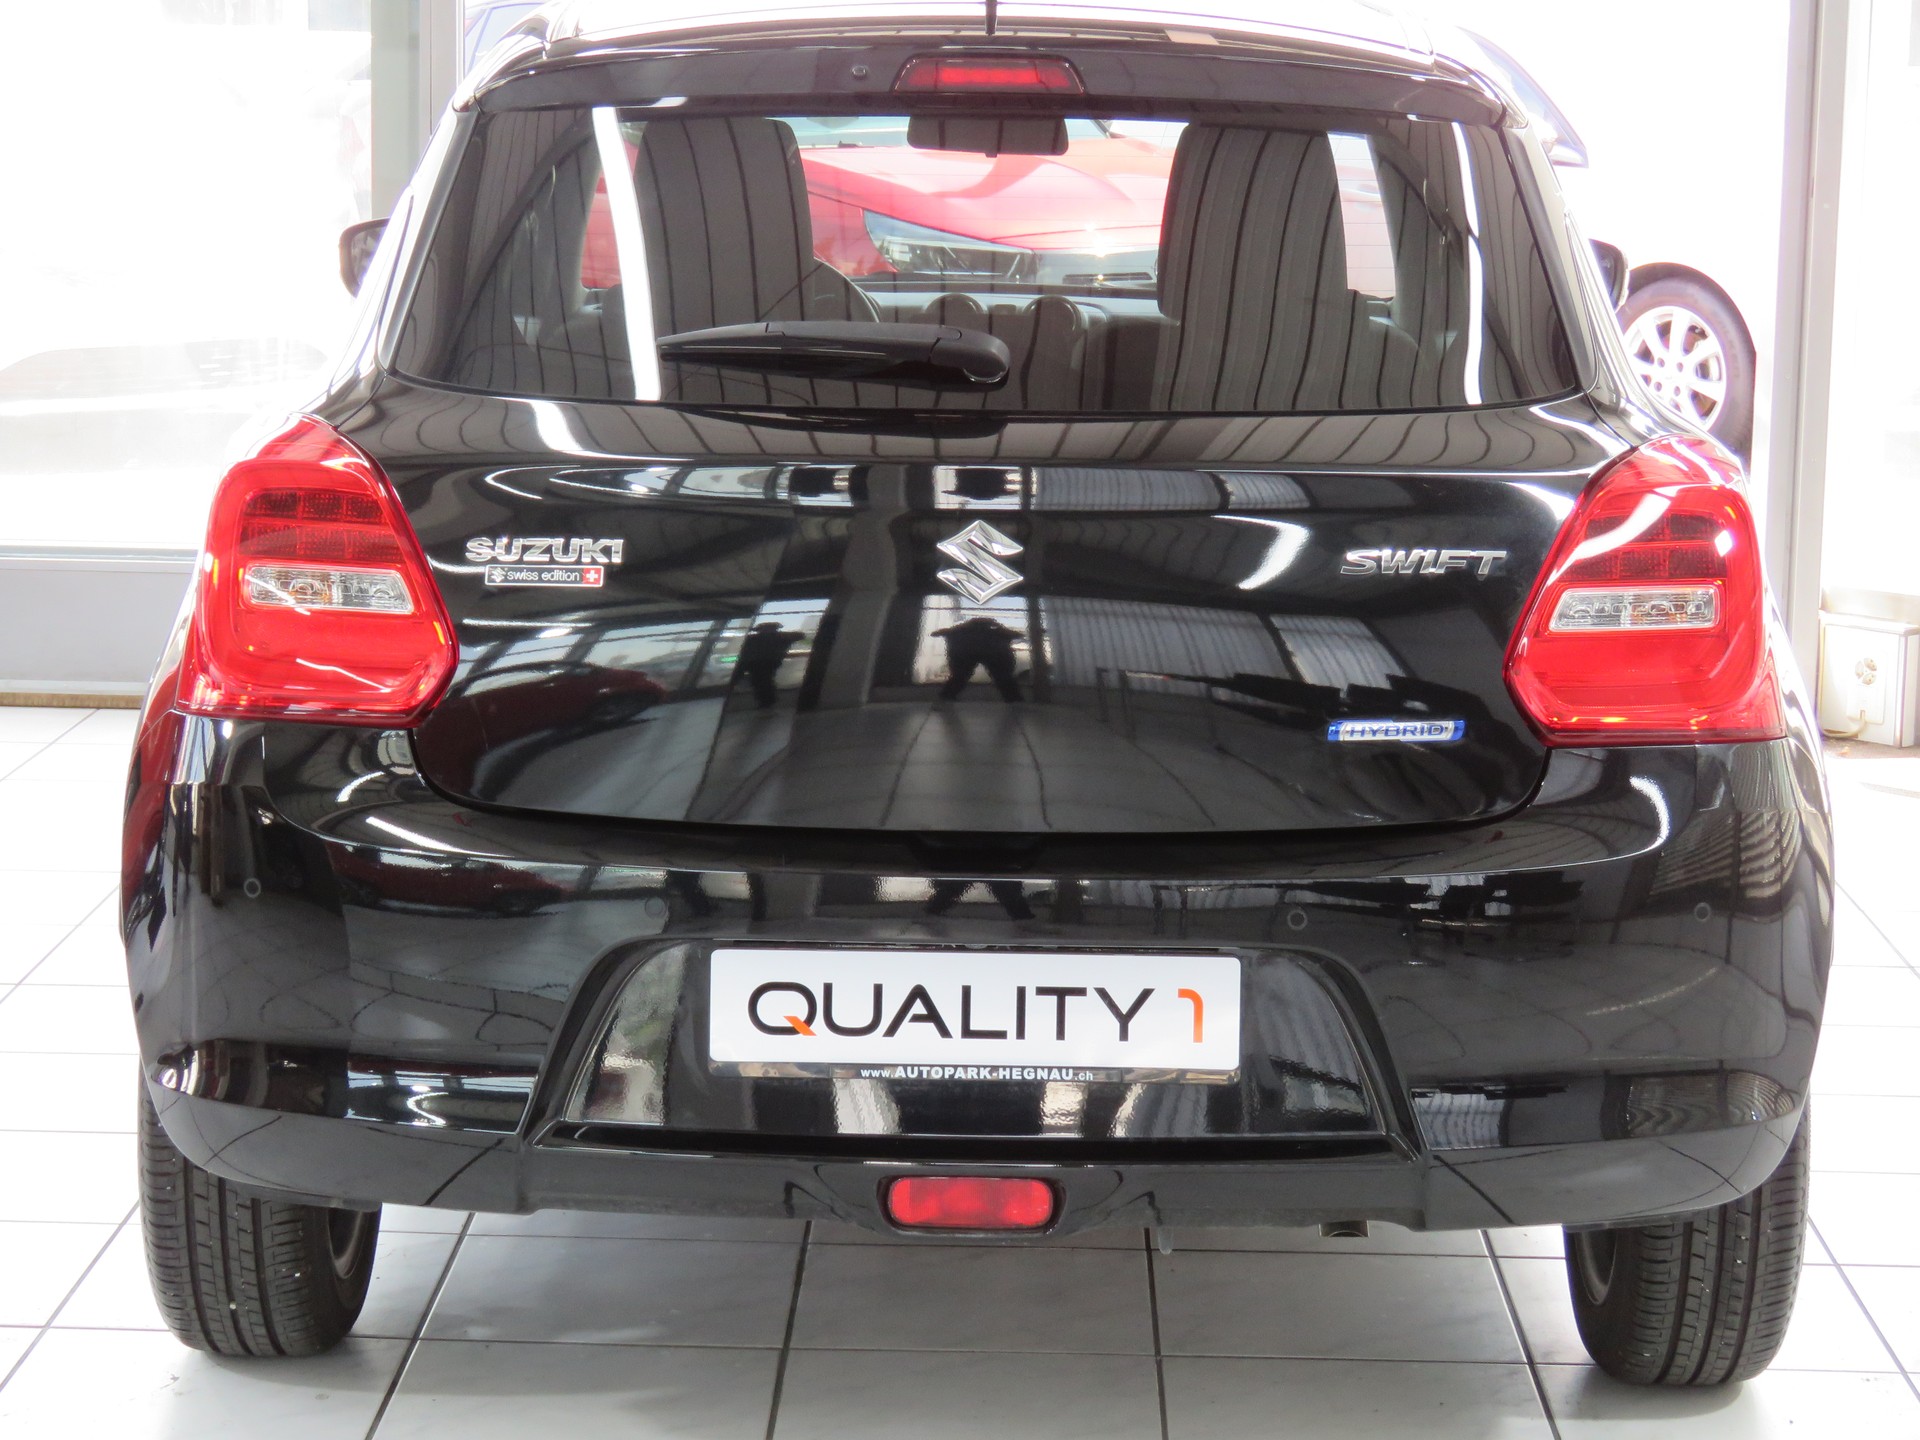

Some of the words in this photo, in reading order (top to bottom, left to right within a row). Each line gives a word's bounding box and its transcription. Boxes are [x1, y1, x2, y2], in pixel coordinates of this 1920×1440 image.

[465, 537, 624, 563] SUZUKI
[1340, 549, 1507, 575] SWIFT
[507, 570, 539, 581] swiss
[541, 569, 580, 581] edition
[1349, 725, 1445, 738] HYBRID
[748, 981, 1155, 1042] QUALITY
[1178, 988, 1203, 1043] 1
[860, 1066, 1094, 1081] www.AUTOPARK-HEGNAU.ch
